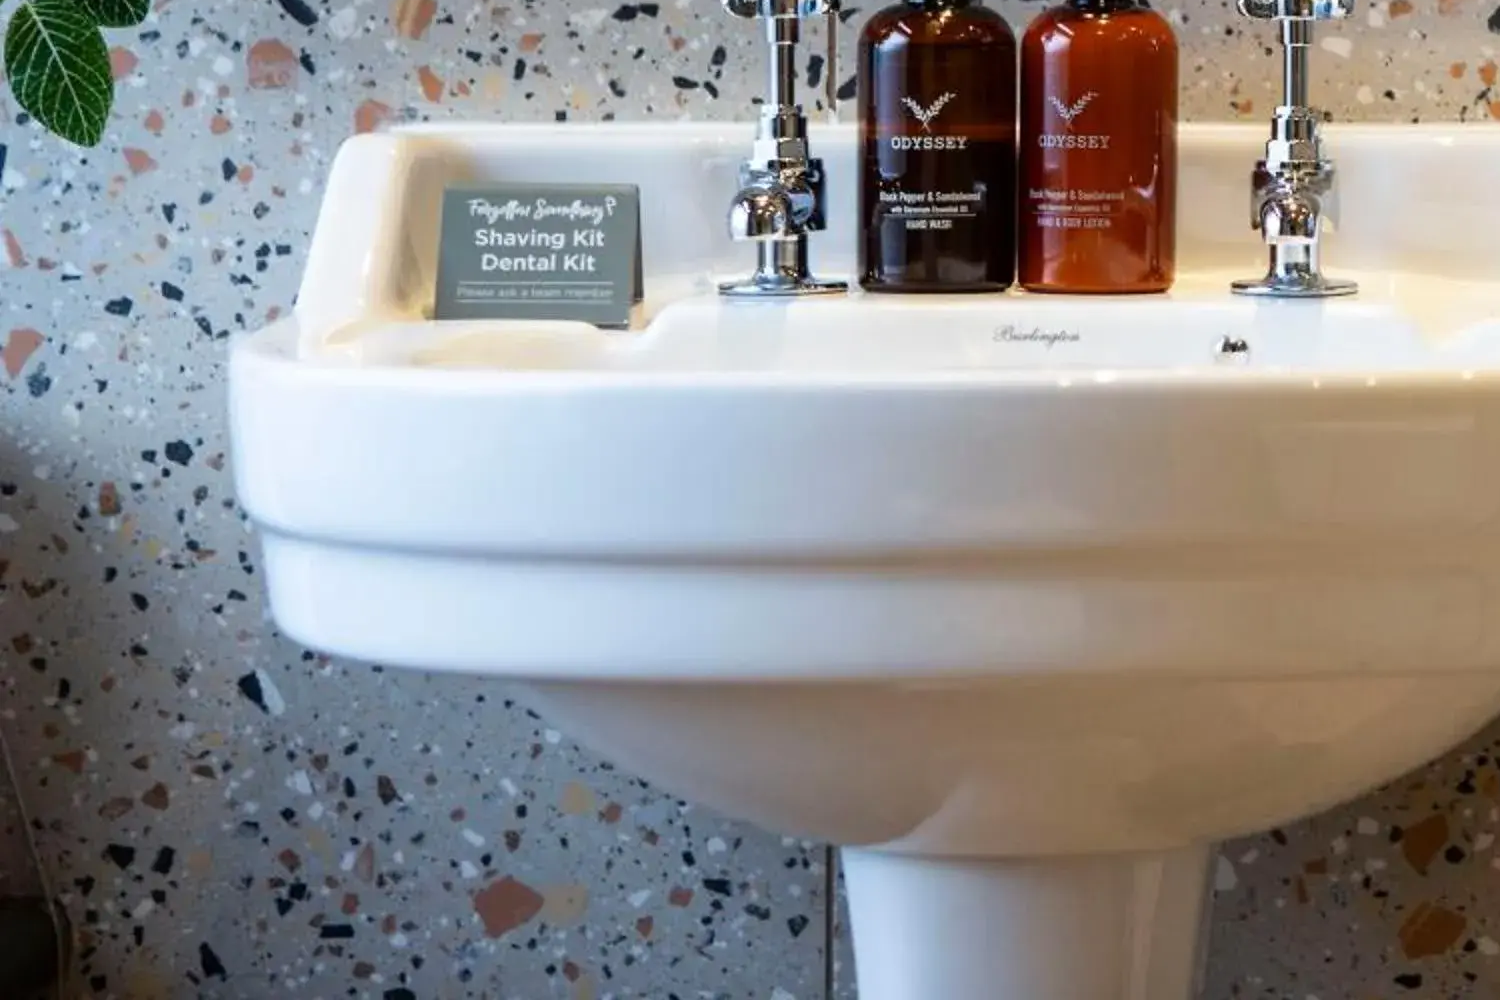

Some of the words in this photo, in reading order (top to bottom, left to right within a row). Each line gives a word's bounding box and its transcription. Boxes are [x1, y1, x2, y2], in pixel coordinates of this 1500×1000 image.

[890, 135, 968, 150] ODYSSEY
[1037, 134, 1111, 150] ODYSSEY
[899, 191, 925, 204] Pepper
[927, 191, 934, 202] &
[1069, 189, 1077, 201] &
[906, 219, 927, 230] HAND
[929, 219, 952, 230] WASH
[474, 229, 566, 249] Shaving
[573, 229, 605, 247] Kit
[481, 253, 556, 271] Dental
[563, 253, 596, 271] Kit
[456, 286, 495, 297] Please
[497, 286, 517, 297] ask
[531, 287, 562, 297] team
